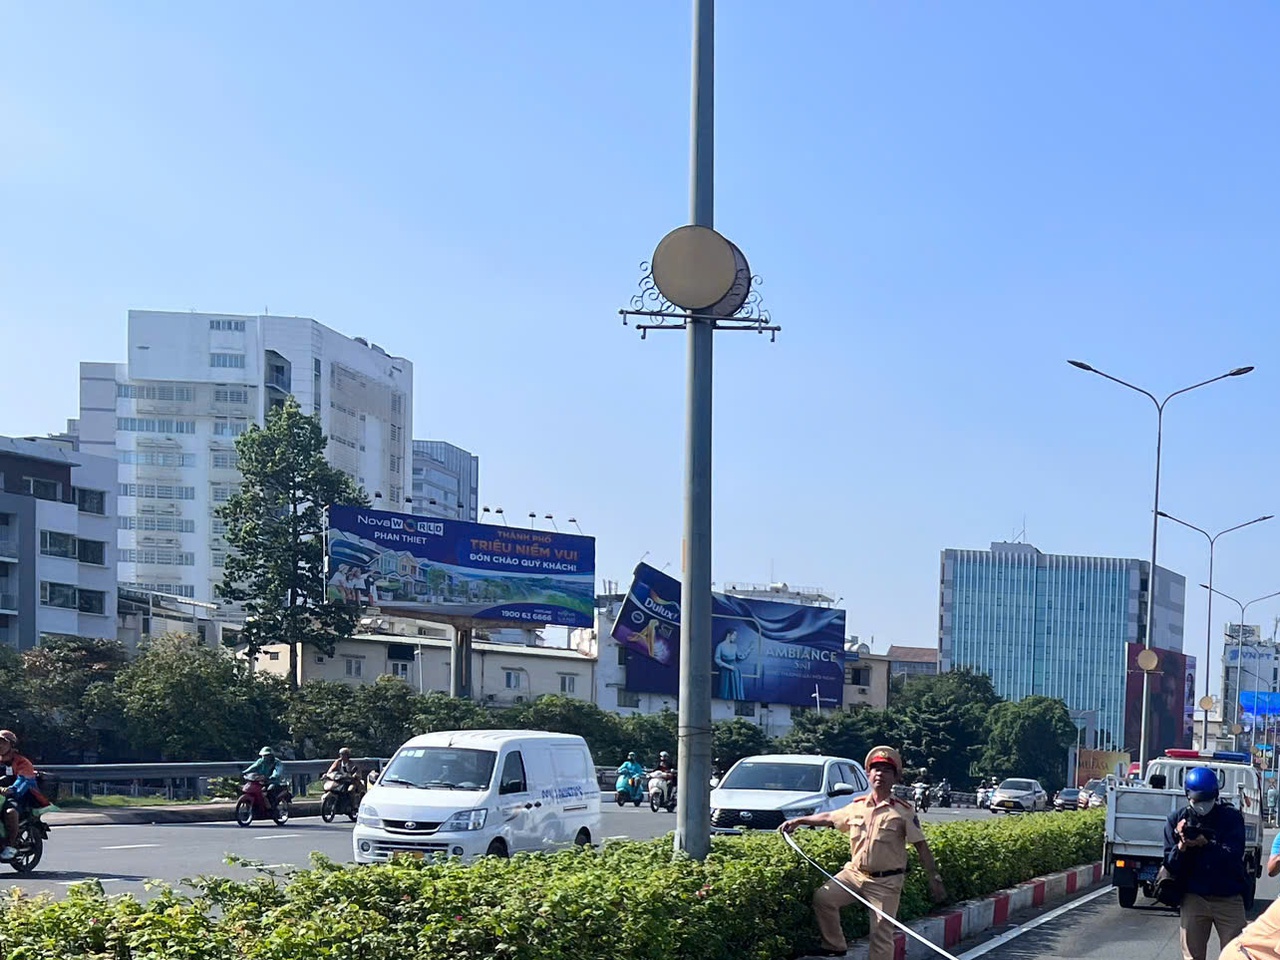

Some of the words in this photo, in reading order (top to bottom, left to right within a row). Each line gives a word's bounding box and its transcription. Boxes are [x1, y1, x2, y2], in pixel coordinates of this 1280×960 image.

[374, 531, 400, 541] PHAN
[401, 534, 428, 545] THIET
[492, 554, 519, 565] CHÀO
[554, 548, 578, 561] VUI
[644, 597, 673, 619] Dulux
[766, 646, 838, 662] AMBIANCE
